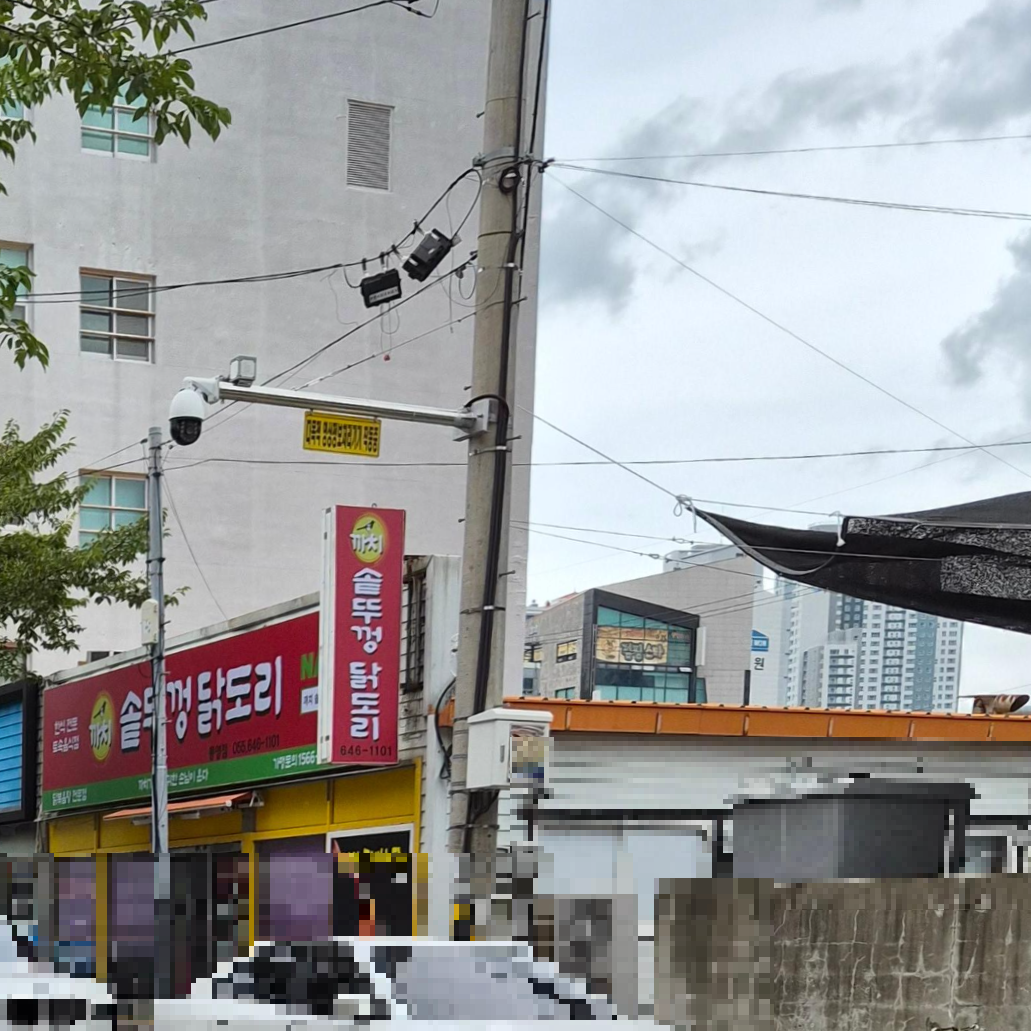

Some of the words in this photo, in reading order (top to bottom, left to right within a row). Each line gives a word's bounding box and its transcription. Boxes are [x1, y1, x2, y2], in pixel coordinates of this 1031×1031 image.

[349, 533, 383, 553] 까치
[351, 567, 383, 654] 솥뚜껑
[754, 657, 765, 670] 원
[197, 655, 283, 735] 닭도리
[349, 661, 383, 741] 닭도리
[89, 719, 112, 749] 까치
[340, 745, 392, 757] 646-1101
